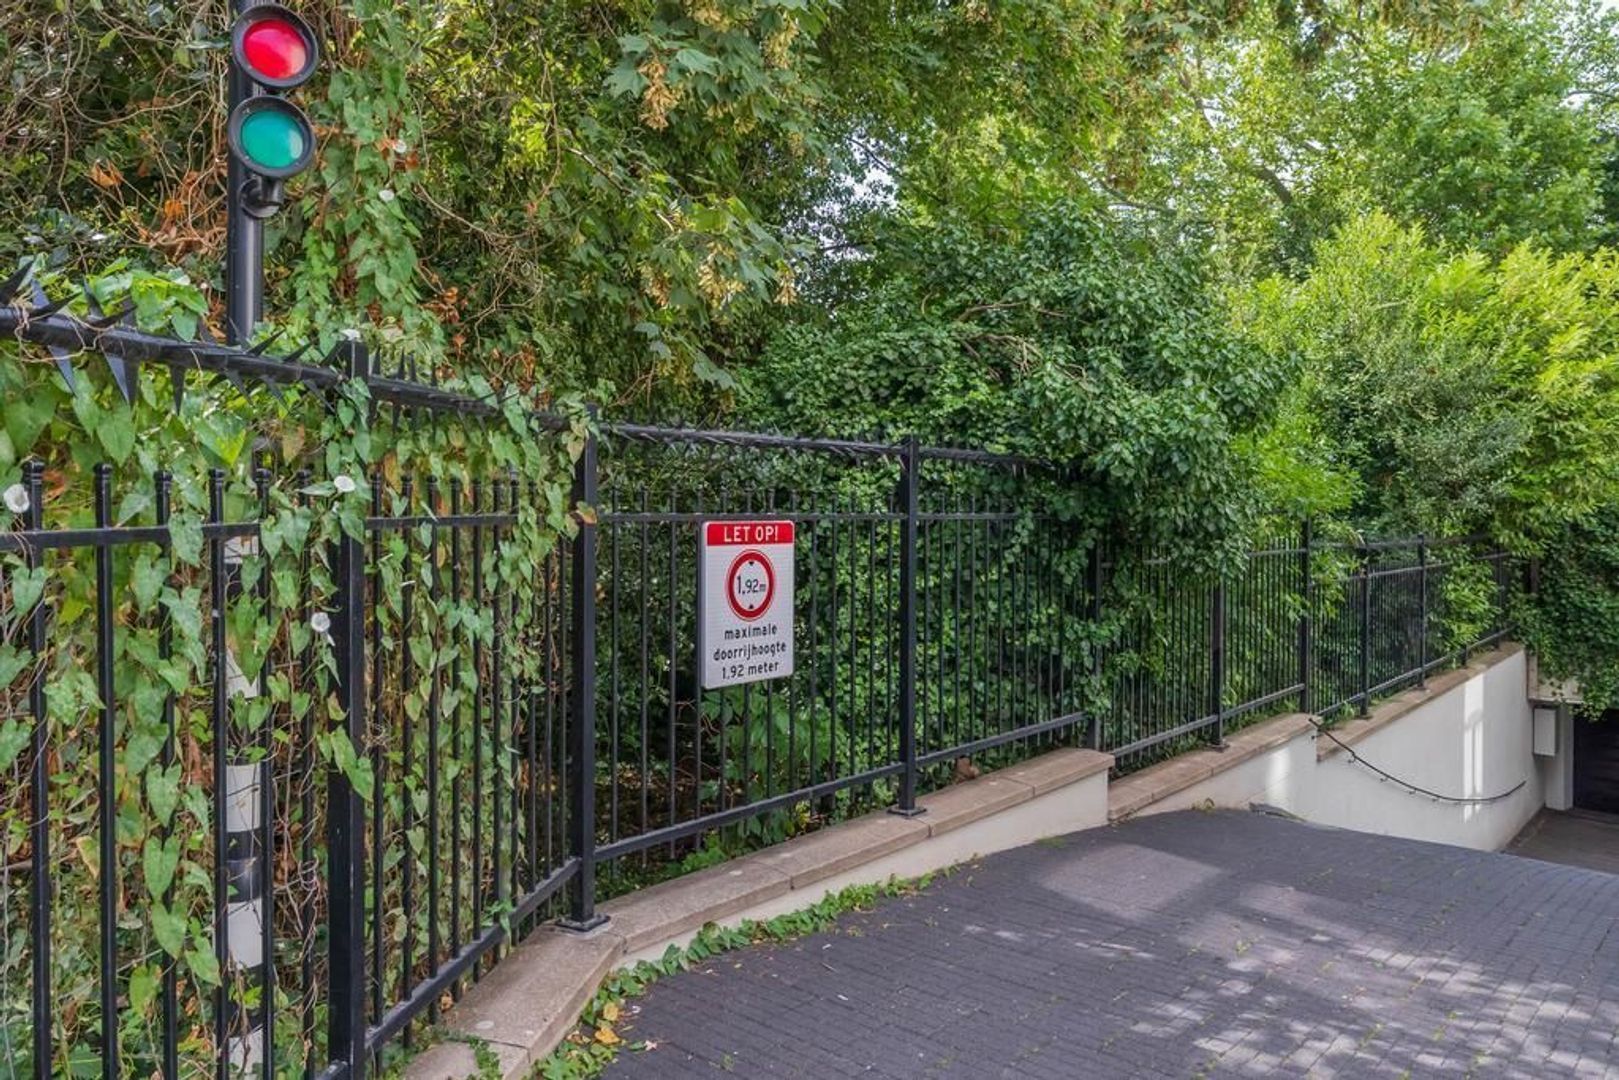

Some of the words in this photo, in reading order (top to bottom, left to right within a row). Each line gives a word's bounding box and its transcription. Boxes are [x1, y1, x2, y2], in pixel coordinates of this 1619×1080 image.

[724, 526, 750, 542] LET
[755, 525, 779, 542] OP!
[724, 623, 778, 640] maximale
[713, 641, 786, 661] doorrijhoogte
[748, 661, 779, 675] meter
